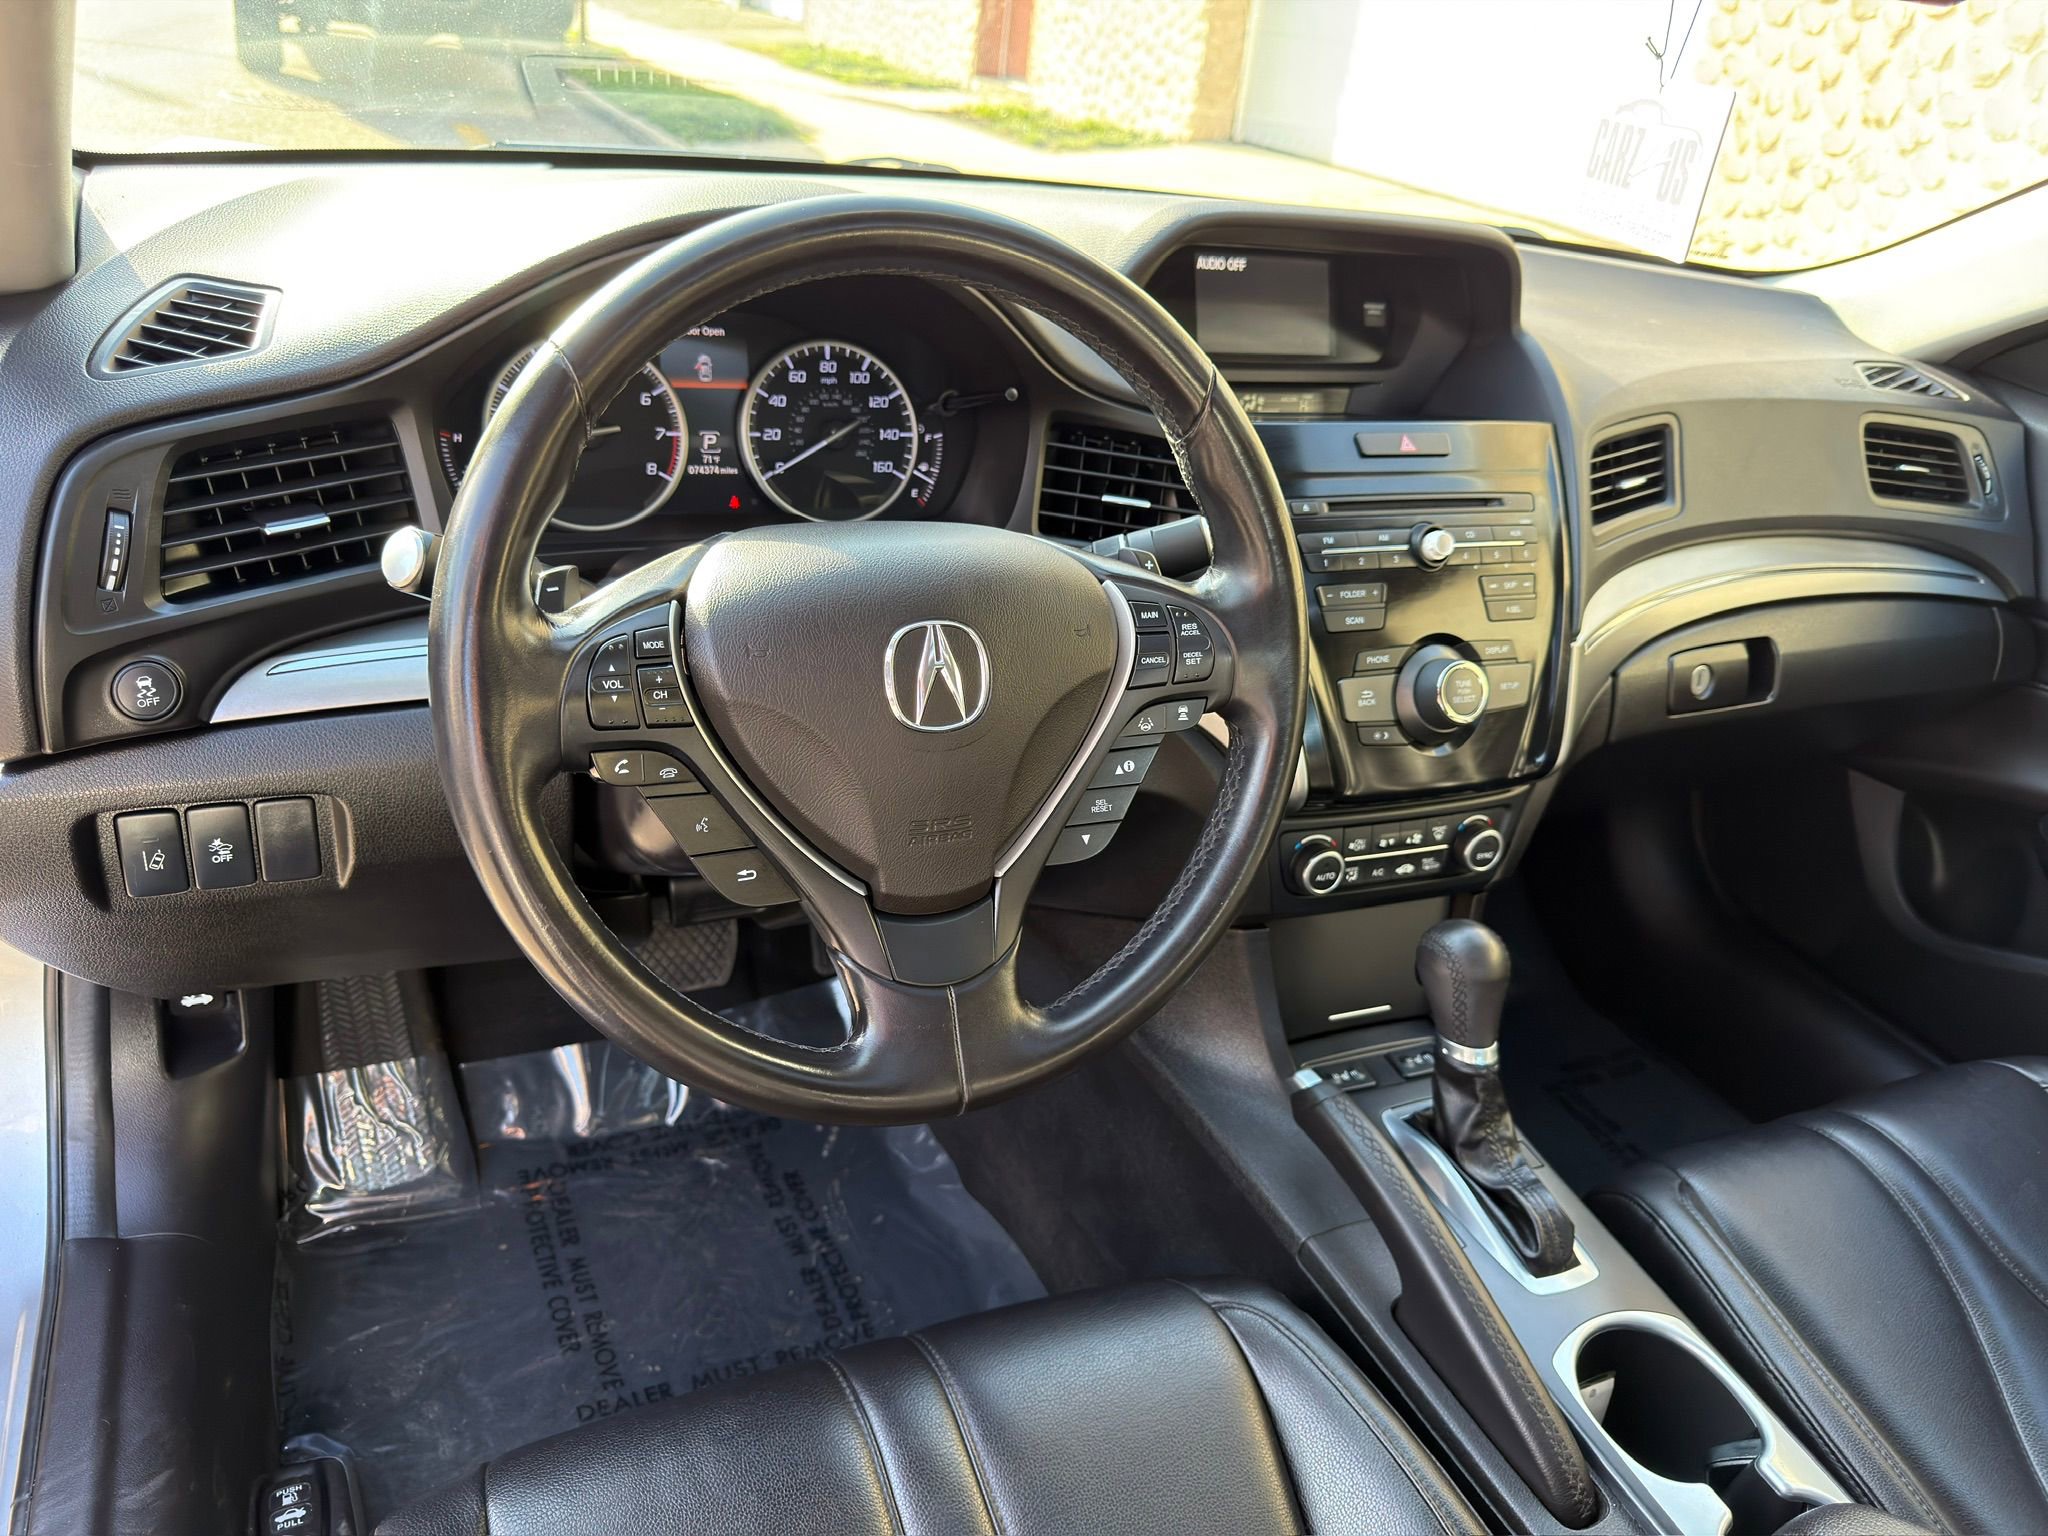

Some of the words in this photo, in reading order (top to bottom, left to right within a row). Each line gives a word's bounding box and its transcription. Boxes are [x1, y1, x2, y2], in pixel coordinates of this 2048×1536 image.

[1196, 256, 1226, 270] AUDIO
[1227, 257, 1248, 271] OFF
[702, 326, 726, 337] Open
[819, 362, 837, 373] 80
[788, 371, 807, 383] 60
[820, 377, 838, 385] mph
[850, 372, 870, 384] 100
[639, 392, 652, 406] 6
[768, 395, 787, 408] 40
[868, 396, 889, 408] 120
[453, 432, 463, 443] H
[655, 426, 666, 440] 7
[763, 428, 782, 440] 20
[879, 429, 900, 440] 140
[702, 434, 717, 450] P
[924, 435, 932, 443] F
[645, 462, 658, 476] 8
[873, 461, 893, 473] 160
[911, 489, 919, 497] E
[1323, 559, 1328, 567] 1
[1358, 557, 1365, 566] 2
[1393, 555, 1400, 563] 3
[1339, 590, 1367, 599] FOLDER
[1141, 611, 1159, 619] MAIN
[1344, 616, 1365, 625] SCAN
[1181, 623, 1198, 631] RES
[643, 640, 665, 650] MODE
[1141, 656, 1166, 664] CANCEL
[1185, 657, 1203, 665] SET
[1366, 654, 1391, 664] PHONE
[602, 679, 624, 690] VOL
[653, 690, 668, 700] CH
[136, 697, 161, 708] OFF
[1358, 698, 1376, 707] BACK
[1091, 804, 1113, 813] RESET
[211, 853, 234, 864] OFF
[1315, 871, 1336, 881] AUTO
[567, 1256, 599, 1302] MUST
[547, 1295, 582, 1356] COVER
[582, 1310, 625, 1392] REMOVE
[576, 1382, 676, 1422] DEALER
[691, 1355, 761, 1392] MUST
[276, 1485, 303, 1497] PUSH
[277, 1519, 304, 1530] PULL
